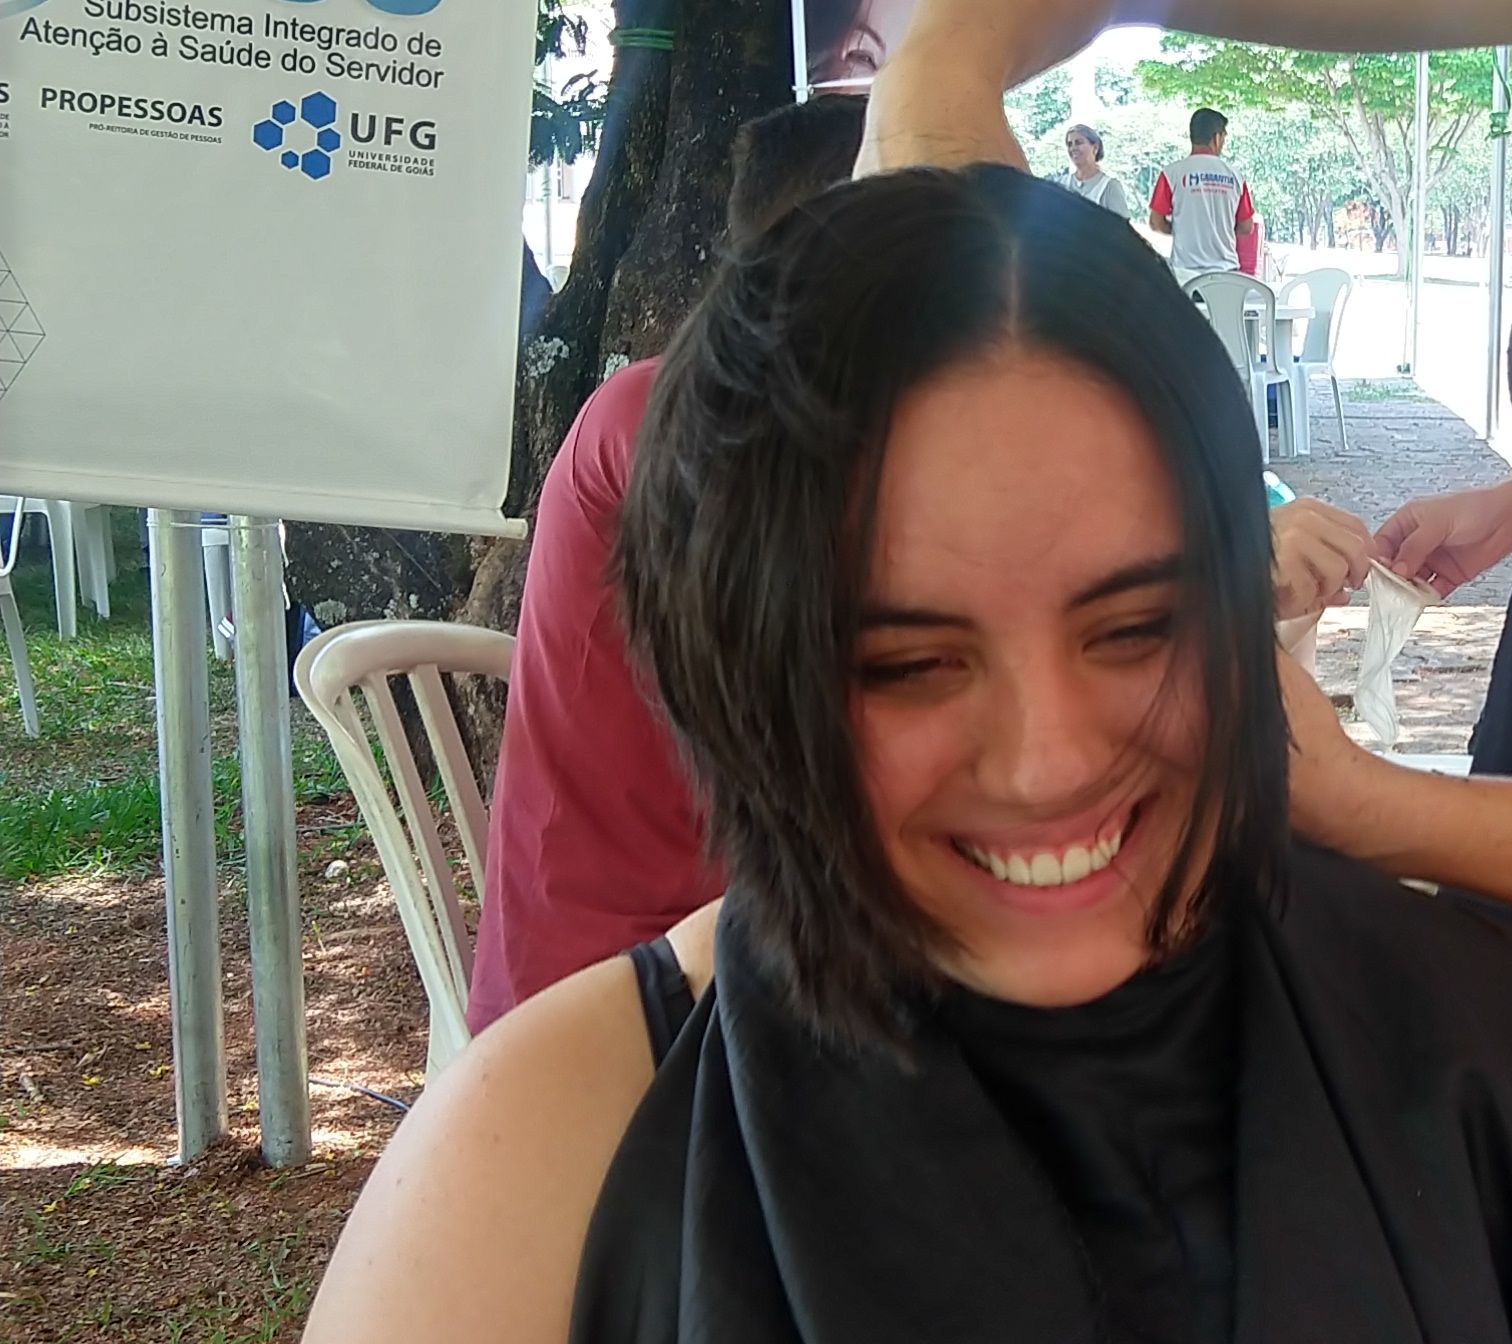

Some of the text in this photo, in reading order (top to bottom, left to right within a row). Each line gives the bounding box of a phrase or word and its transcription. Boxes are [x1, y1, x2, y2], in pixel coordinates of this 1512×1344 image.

[19, 16, 444, 88] Atenção à Saúde do Servidor
[264, 13, 398, 51] Integrado
[407, 31, 442, 57] de
[41, 87, 223, 127] PROPESSOAS
[139, 129, 150, 137] DE
[150, 129, 178, 139] GESTÃO
[190, 134, 222, 144] PESSOAS
[350, 113, 437, 151] UFG
[348, 150, 435, 167] UNIVERSIDADE
[348, 159, 434, 176] FEDERAL DE GOIÁS
